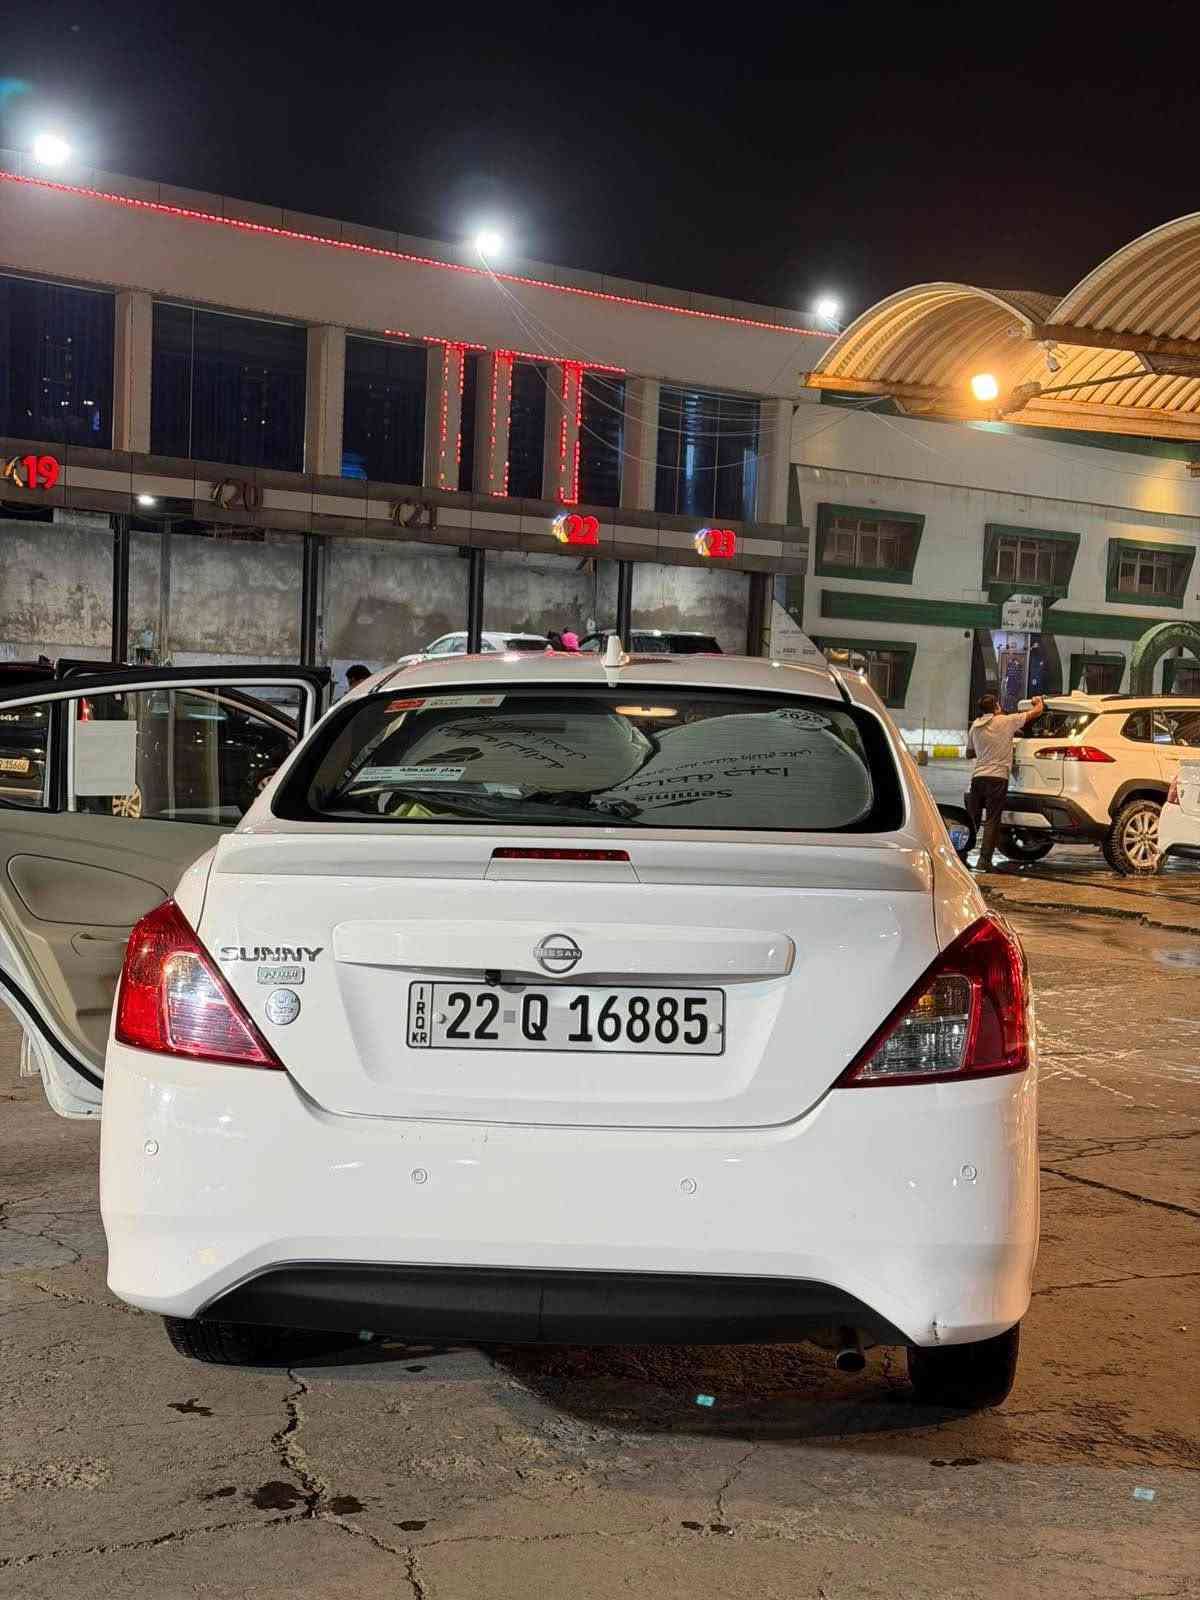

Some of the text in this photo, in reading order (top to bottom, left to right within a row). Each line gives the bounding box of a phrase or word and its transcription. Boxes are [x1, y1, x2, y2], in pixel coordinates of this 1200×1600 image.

[21, 455, 60, 489] 19
[566, 514, 600, 544] 22
[708, 529, 737, 557] 23
[220, 947, 324, 961] SUNNY
[535, 947, 582, 960] NISSAN
[446, 991, 709, 1045] 22 Q 16885
[411, 1031, 428, 1045] KR
